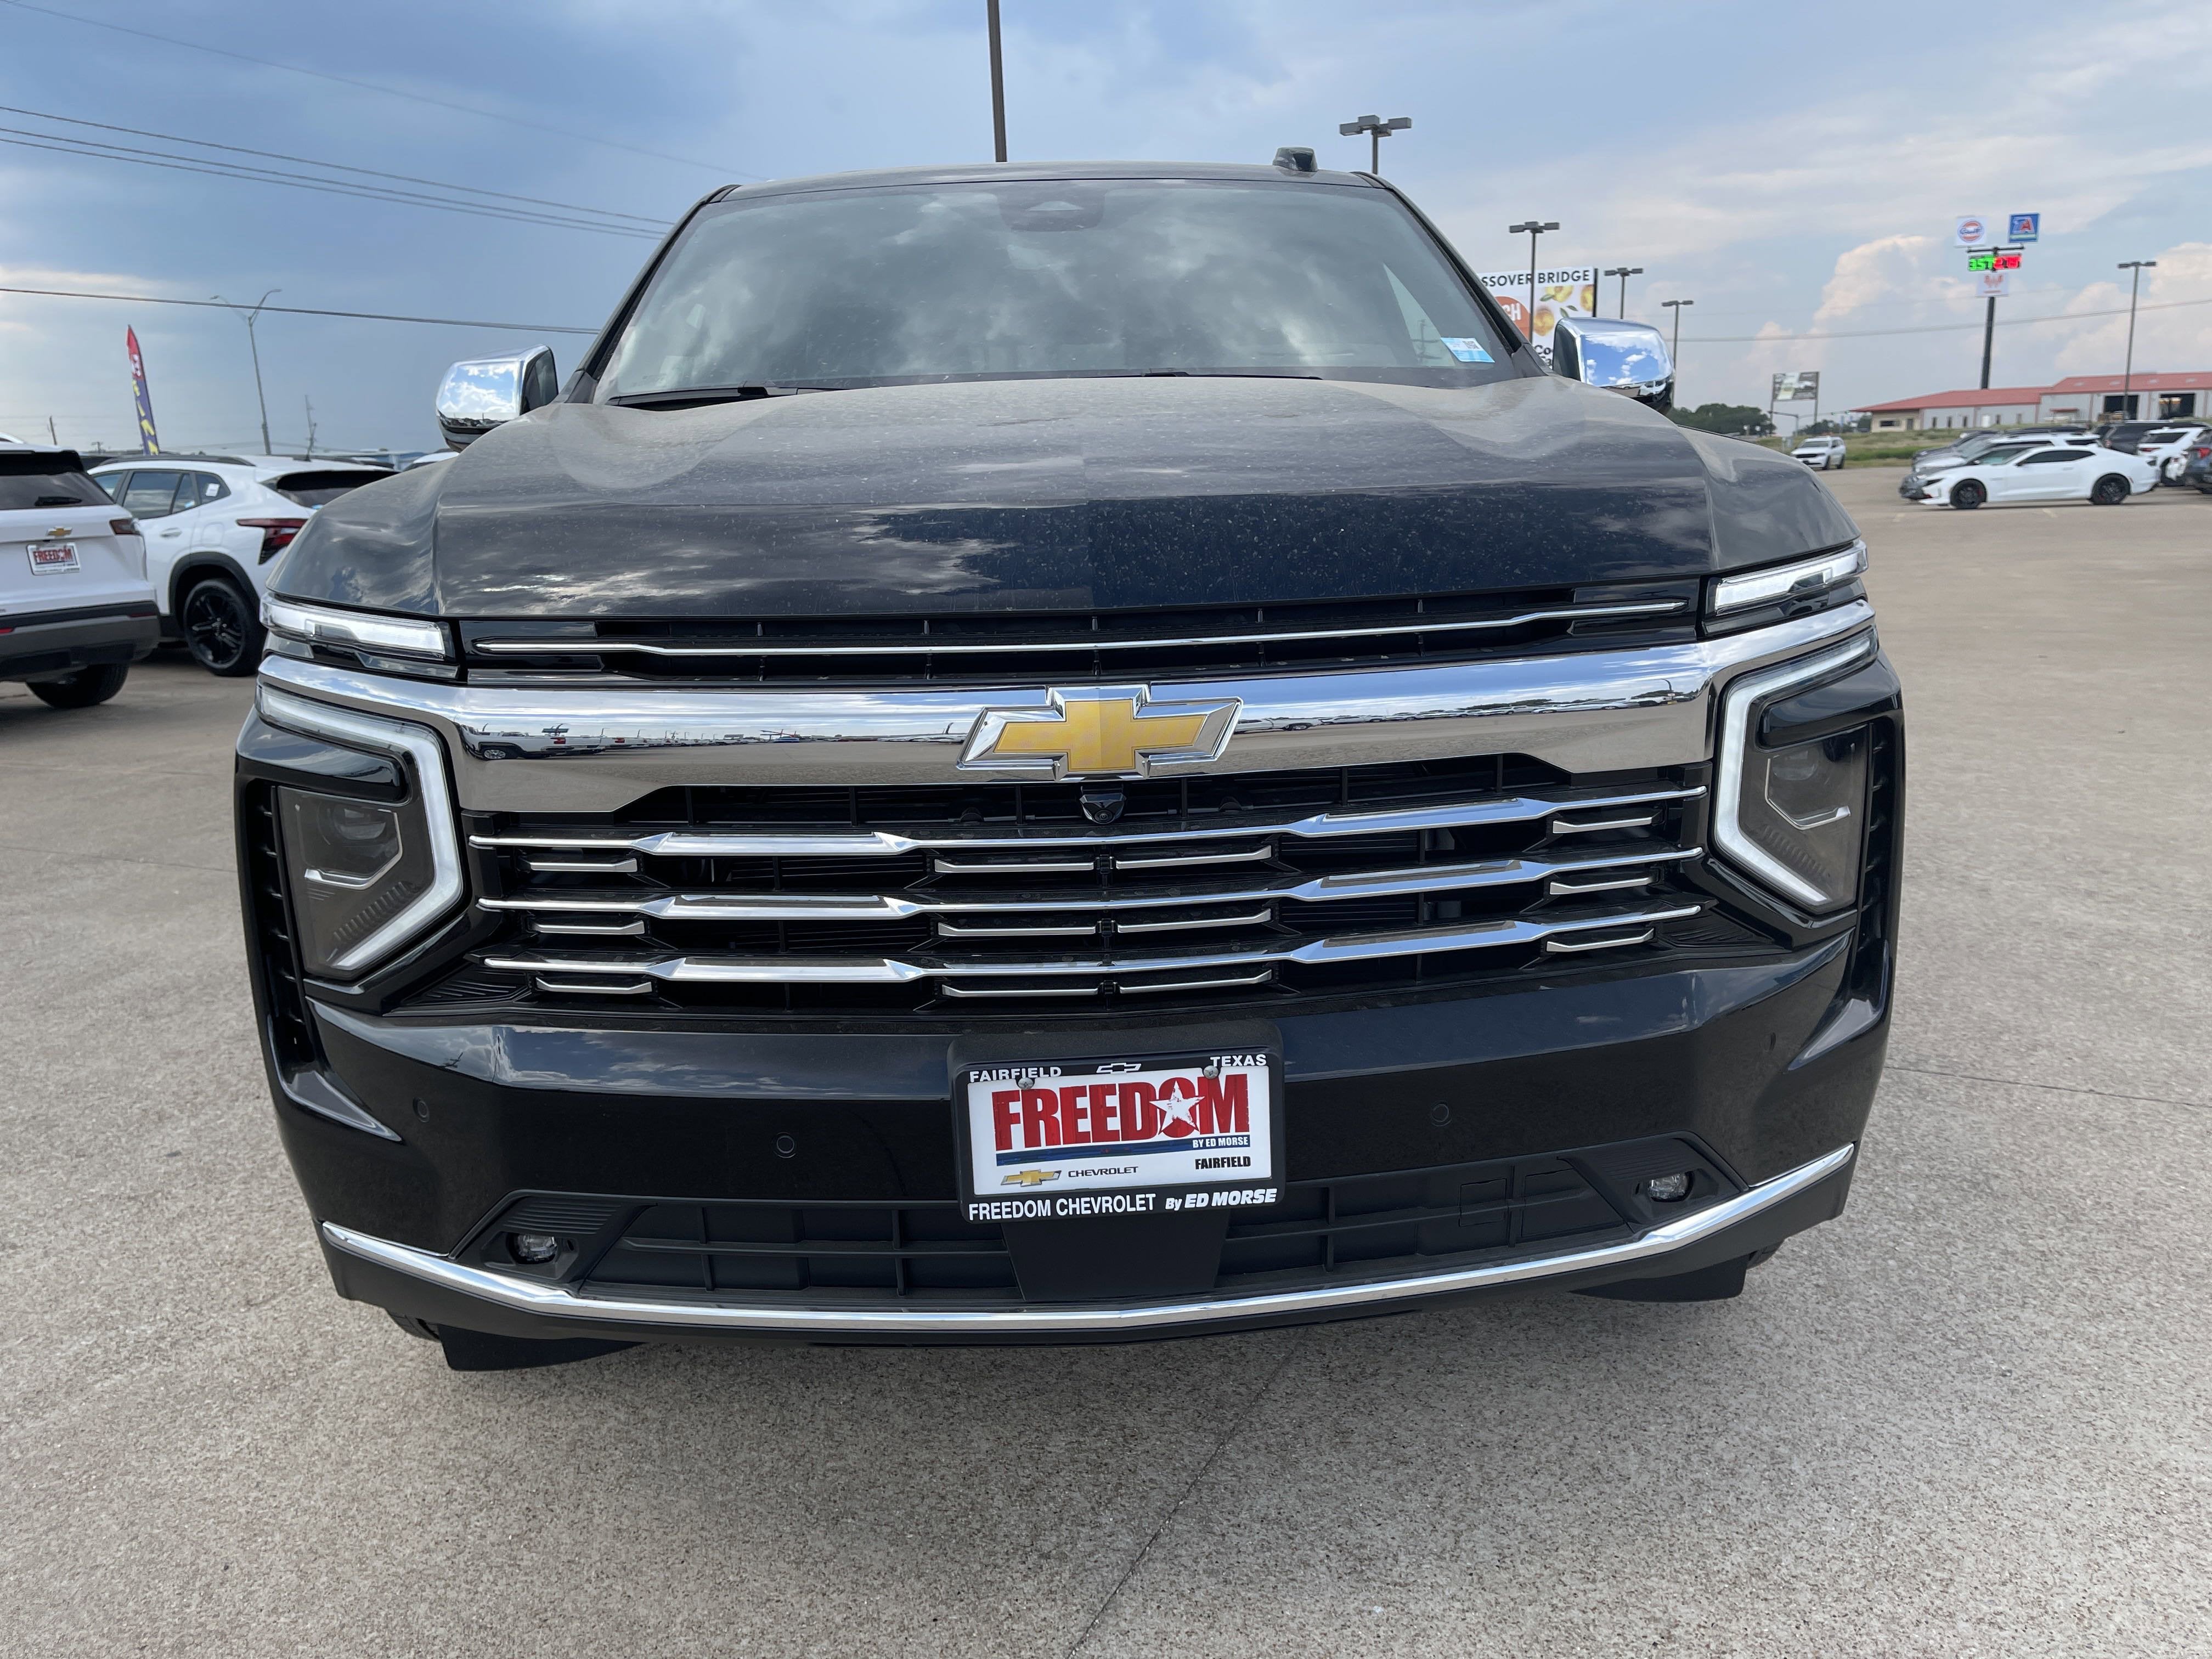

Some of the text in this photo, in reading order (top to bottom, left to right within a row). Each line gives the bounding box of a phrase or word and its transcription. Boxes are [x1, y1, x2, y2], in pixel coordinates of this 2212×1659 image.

[1538, 270, 1590, 284] BRIDGE
[1210, 1054, 1267, 1066] TEXAS
[969, 1066, 1062, 1083] FAIRFIELD
[991, 1074, 1250, 1151] FREEDOM
[1193, 1137, 1249, 1148] BY ED MORSE
[1195, 1156, 1251, 1170] FAIRFIELD
[1068, 1166, 1138, 1177] CHEVROLET
[969, 1188, 1277, 1221] FREEDOM CHEVROLET By ED MORSE
